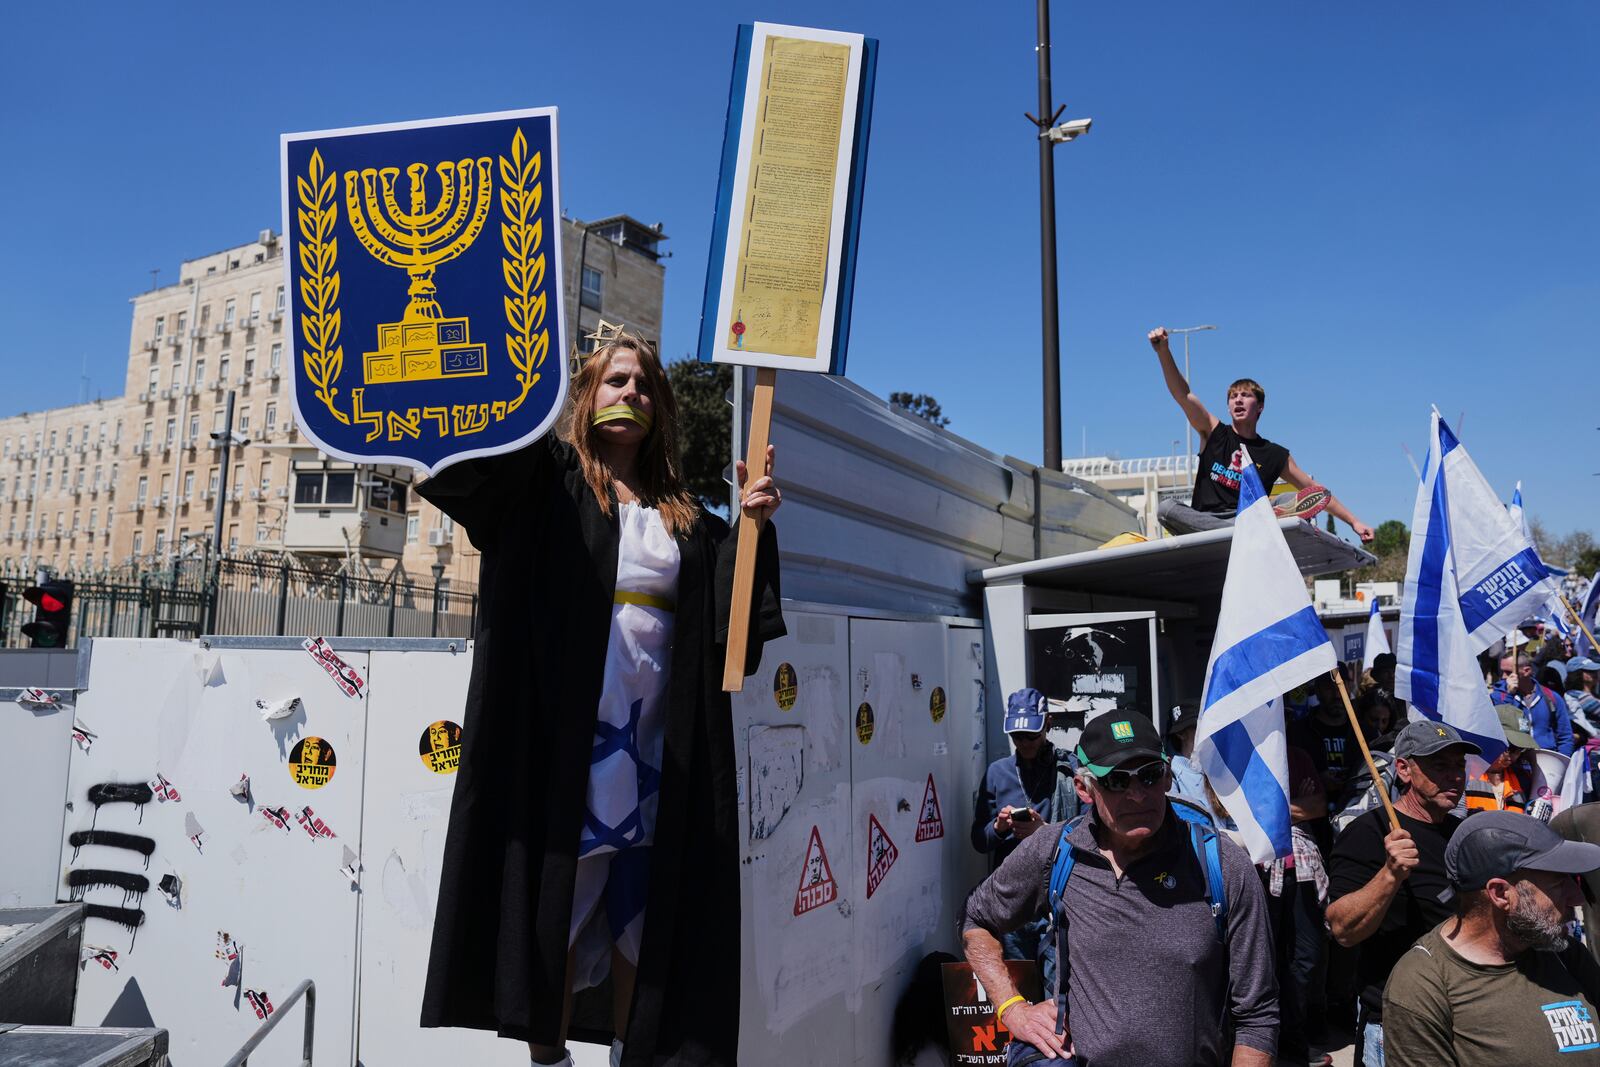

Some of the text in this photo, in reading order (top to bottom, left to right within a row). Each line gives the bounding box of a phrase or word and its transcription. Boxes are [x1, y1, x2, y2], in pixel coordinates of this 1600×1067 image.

[352, 388, 507, 443] ישראל
[1476, 561, 1522, 594] חופשי
[1485, 572, 1533, 610] בארצנו
[296, 764, 329, 776] מחריב
[296, 773, 328, 786] ישראל
[431, 756, 461, 773] שראל
[918, 820, 941, 841] סכנה!
[868, 845, 894, 893] סכנה!
[798, 880, 833, 912] סכנה!
[1543, 1006, 1584, 1027] אחים
[1552, 1020, 1598, 1050] לנשק
